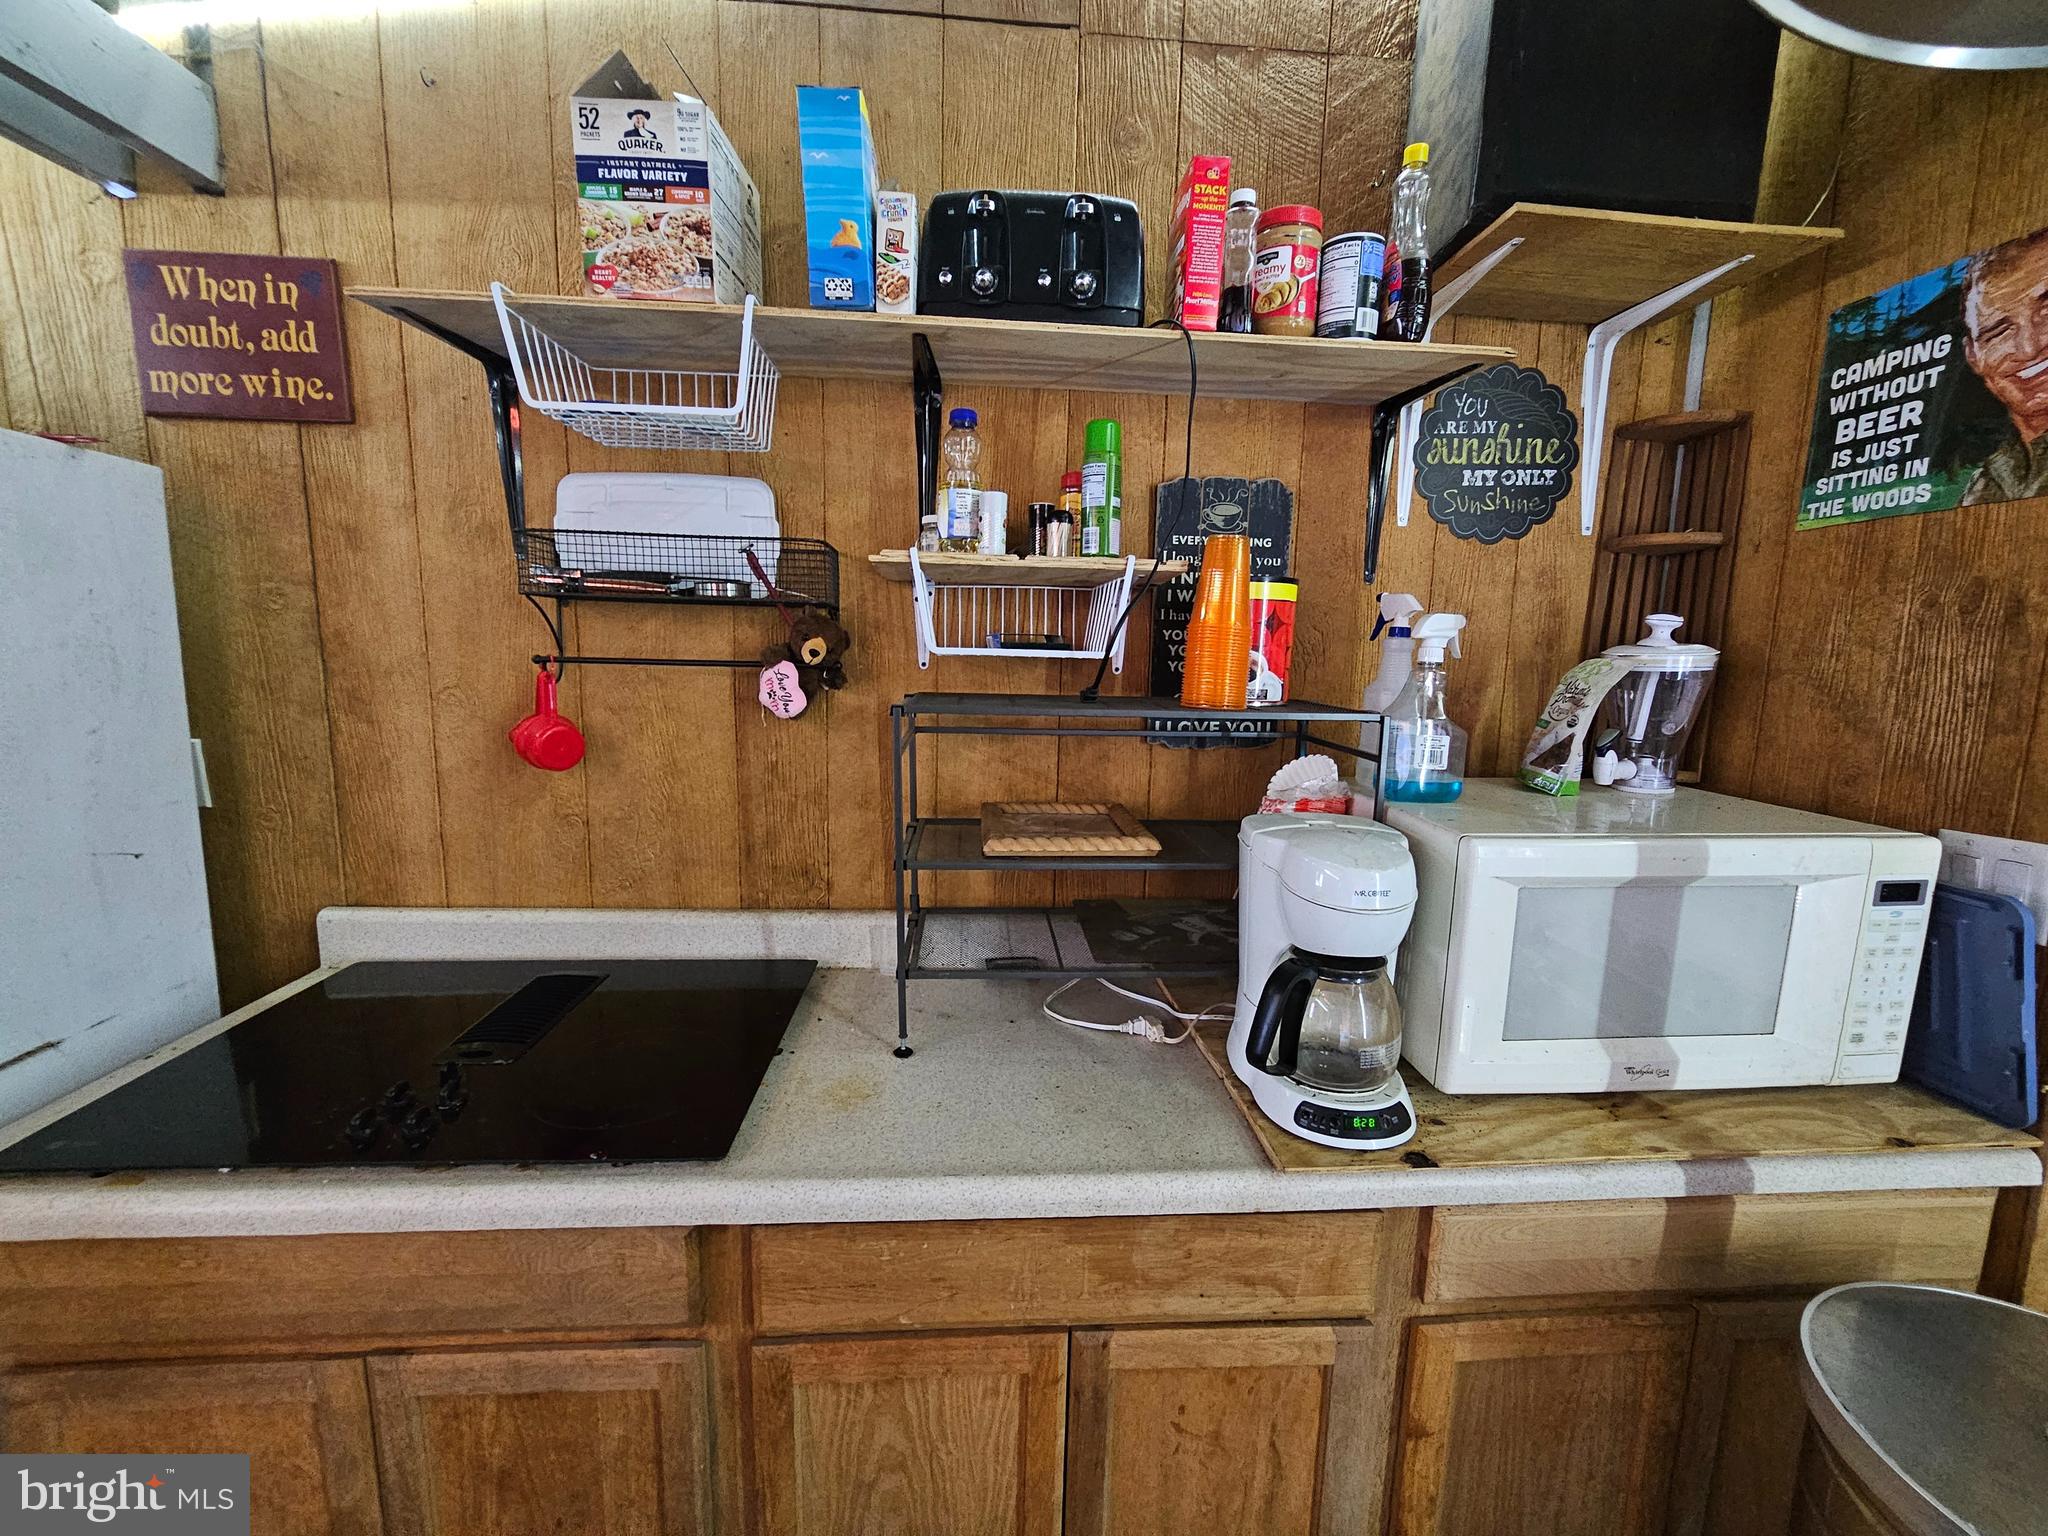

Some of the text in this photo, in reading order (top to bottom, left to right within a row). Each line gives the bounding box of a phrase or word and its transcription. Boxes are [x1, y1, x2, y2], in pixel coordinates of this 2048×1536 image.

[578, 107, 600, 130] 52
[618, 139, 663, 152] QUAKER
[607, 160, 676, 169] INSTANT OATMEAL
[598, 168, 688, 182] FLAVOR VARIETY
[654, 188, 664, 196] 27
[1194, 184, 1226, 195] STACK
[880, 208, 908, 218] Crunch
[1192, 202, 1226, 211] MOMENTS
[1255, 264, 1286, 278] reamy
[157, 264, 298, 312] When in
[150, 313, 320, 356] doubt, add
[1830, 334, 1952, 390] CAMPING
[147, 368, 334, 406] more wine.
[1830, 364, 1946, 416] WITHOUT
[1454, 393, 1489, 418] YOU
[1434, 420, 1498, 434] ARE MY
[1834, 400, 1924, 446] BEER
[1831, 434, 1919, 470] IS JUST
[1462, 469, 1558, 486] MY ONLY
[1815, 457, 1930, 496] SITTING IN
[1443, 487, 1546, 516] Sunshine
[1807, 483, 1932, 520] THE WOODS
[1172, 535, 1272, 548] EVERYING
[1256, 557, 1281, 568] you
[1169, 608, 1192, 620] hav
[1167, 720, 1220, 732] LOVE
[1224, 721, 1271, 732] YOU
